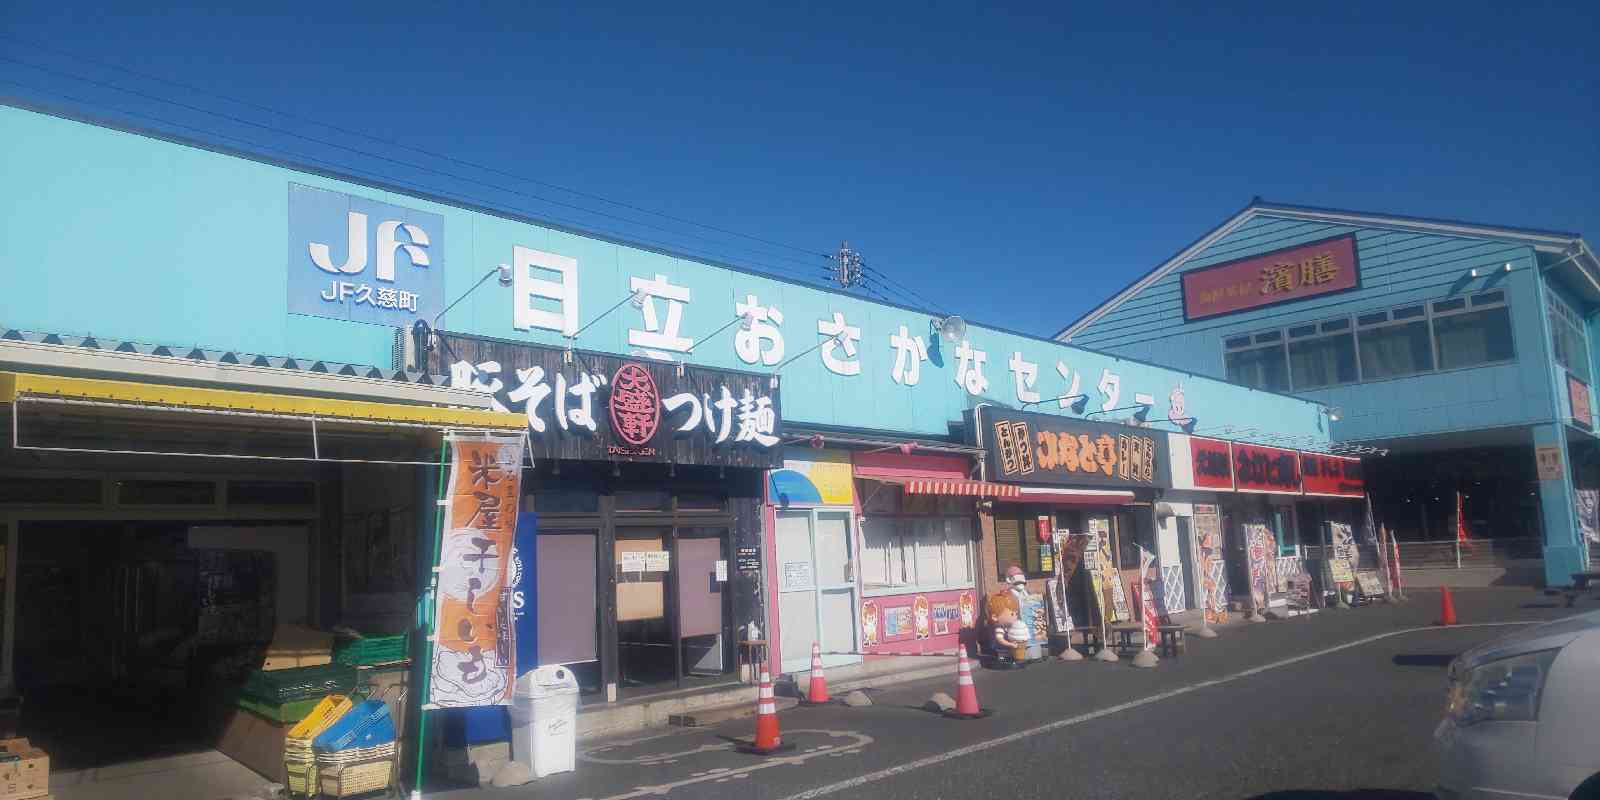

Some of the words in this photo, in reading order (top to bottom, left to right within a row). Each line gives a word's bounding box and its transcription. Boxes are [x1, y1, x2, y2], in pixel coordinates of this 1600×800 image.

[308, 211, 430, 282] JF
[321, 280, 418, 312] JF久慈町
[511, 245, 1154, 411] 日立おさかなセンター
[614, 366, 656, 439] 大盛軒
[661, 385, 780, 447] つけ麺
[1001, 426, 1015, 469] とんかつ
